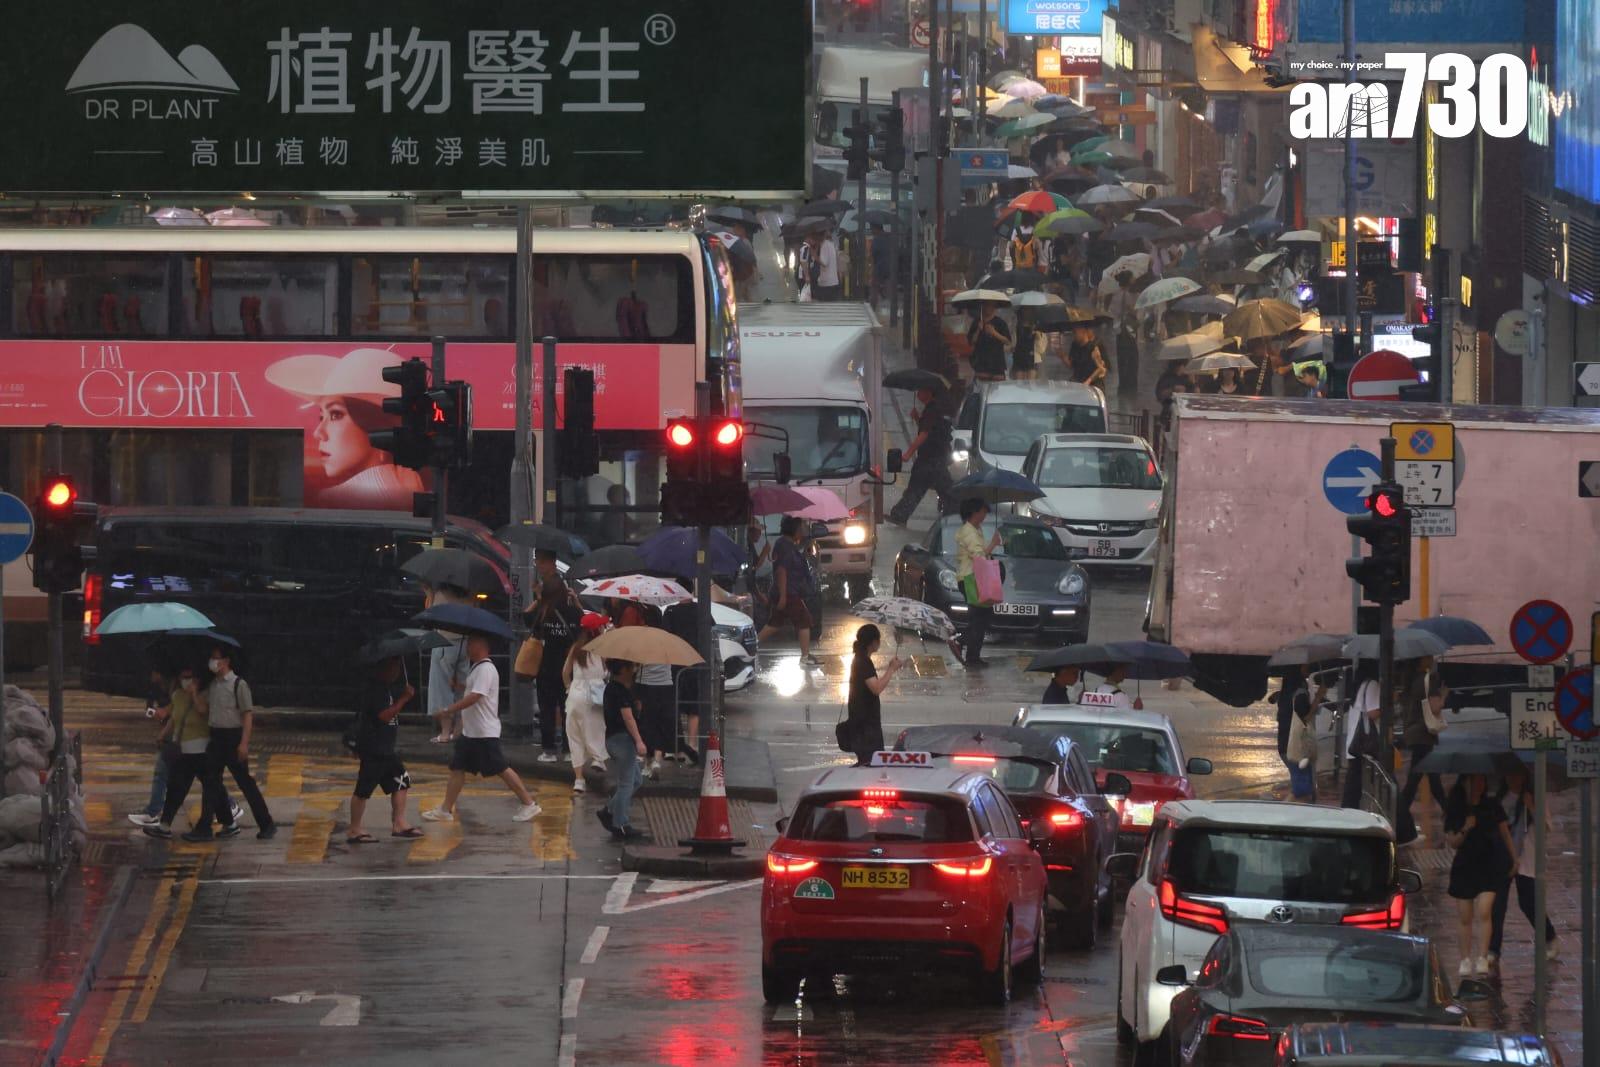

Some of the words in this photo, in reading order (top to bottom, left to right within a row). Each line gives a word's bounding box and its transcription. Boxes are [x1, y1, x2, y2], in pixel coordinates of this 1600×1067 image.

[1036, 2, 1081, 10] watsons
[1036, 14, 1081, 29] 屈臣氏
[267, 27, 645, 115] 植物醫生
[86, 99, 119, 120] DR
[132, 99, 219, 120] PLANT
[190, 137, 348, 166] 高山植物
[391, 137, 551, 166] 純淨美肌
[80, 345, 87, 369] I
[92, 345, 125, 369] AM
[78, 368, 255, 418] GLORIA
[1431, 464, 1442, 479] 7
[1431, 487, 1442, 503] 7
[1097, 539, 1112, 548] SB
[1091, 547, 1116, 557] 1979
[994, 604, 1009, 614] UU
[1012, 604, 1037, 615] 3891
[1085, 693, 1113, 704] TAXI
[1518, 720, 1564, 740] 終止
[877, 752, 927, 765] TAXI
[843, 871, 864, 884] NH
[867, 871, 909, 884] 8532
[810, 883, 819, 892] 6
